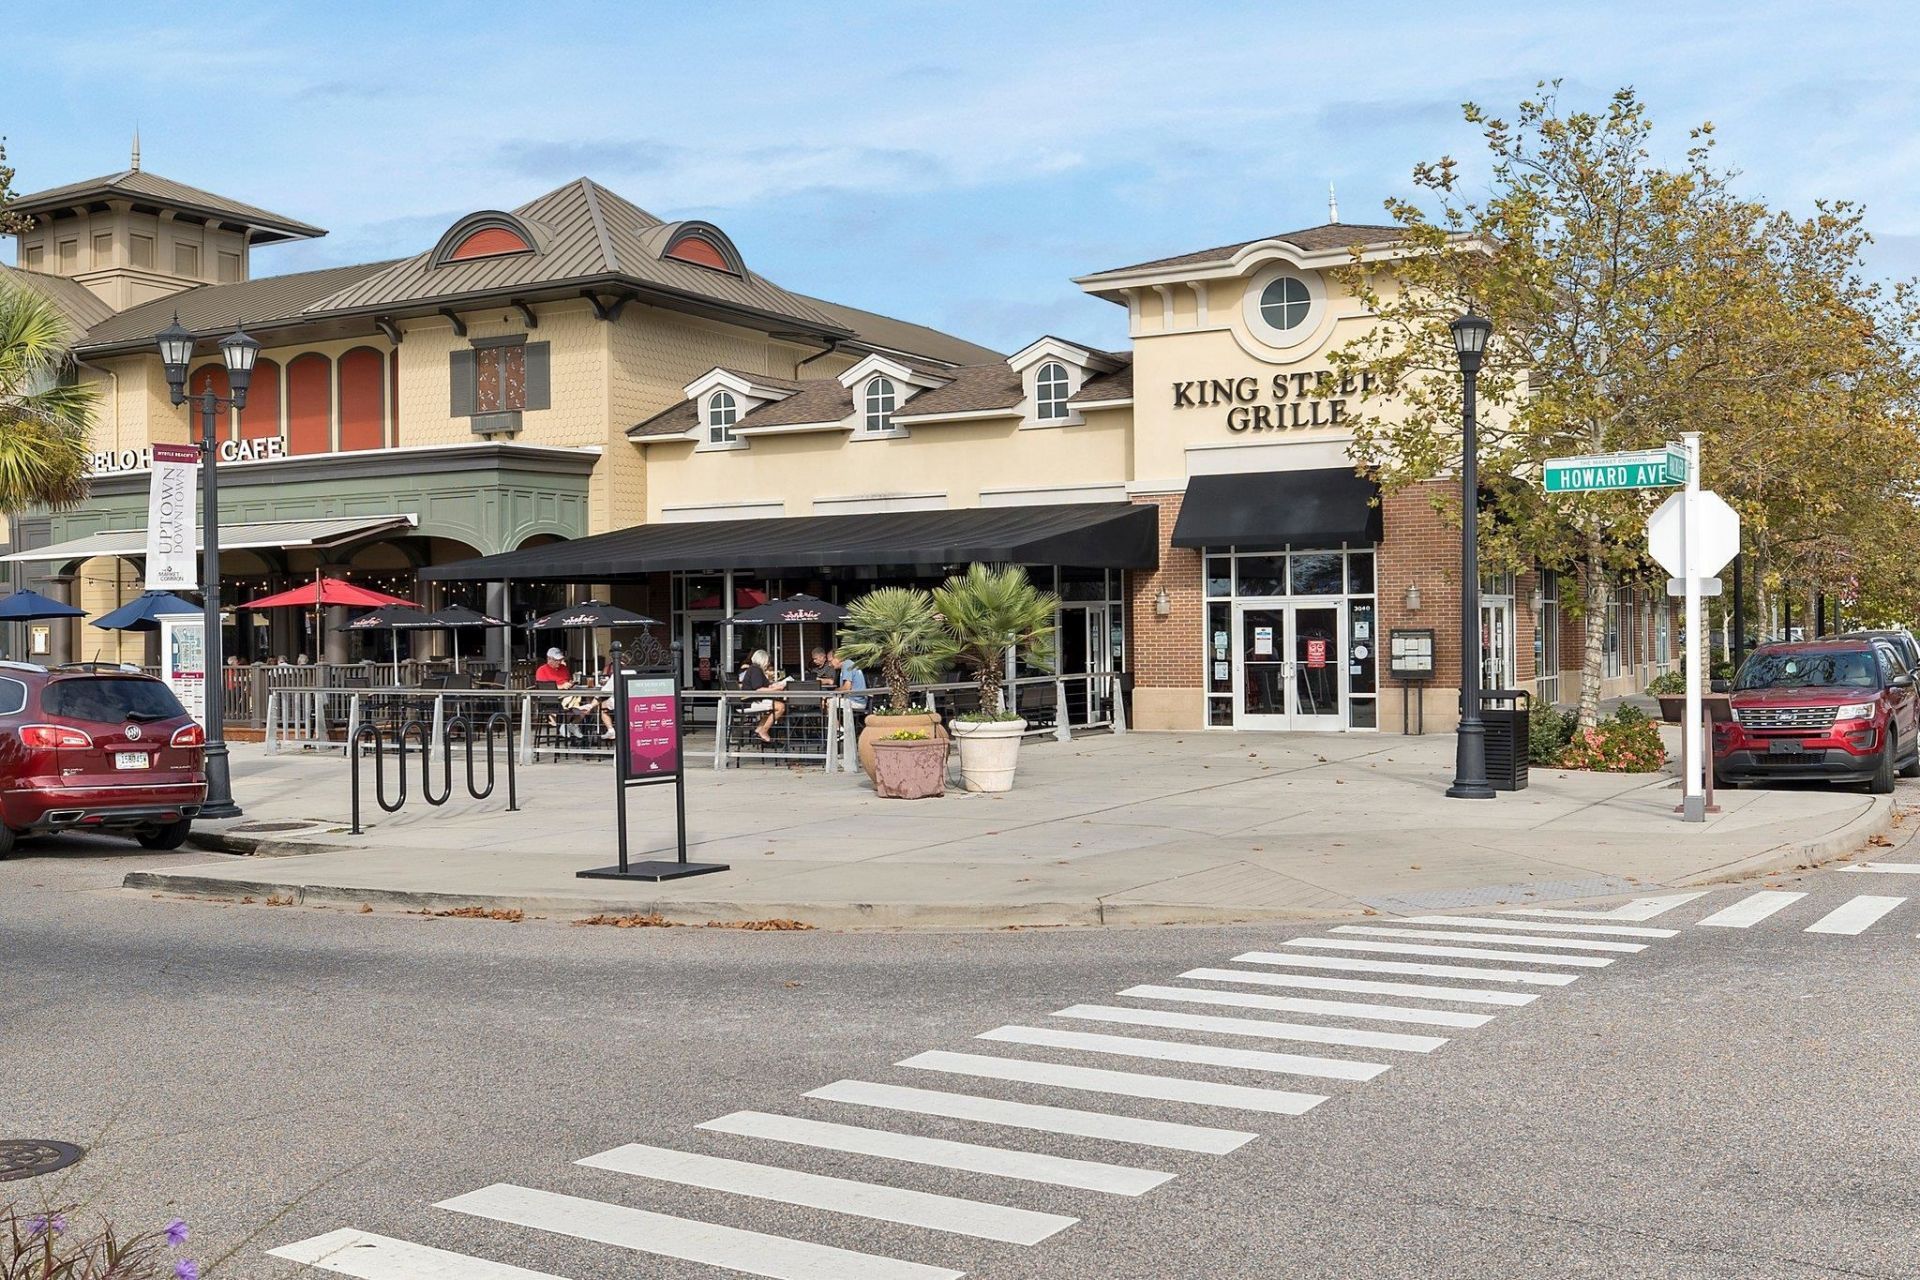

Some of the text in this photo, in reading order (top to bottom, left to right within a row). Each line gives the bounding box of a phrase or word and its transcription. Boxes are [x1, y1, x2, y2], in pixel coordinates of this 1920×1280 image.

[1172, 370, 1379, 407] KING STREE
[1226, 399, 1348, 432] GRILLE
[220, 436, 286, 462] CAFE
[1560, 467, 1628, 489] HOWARD
[1636, 464, 1668, 485] AVE
[159, 467, 175, 554] UPTOWN
[173, 468, 185, 554] DOWNTOWN
